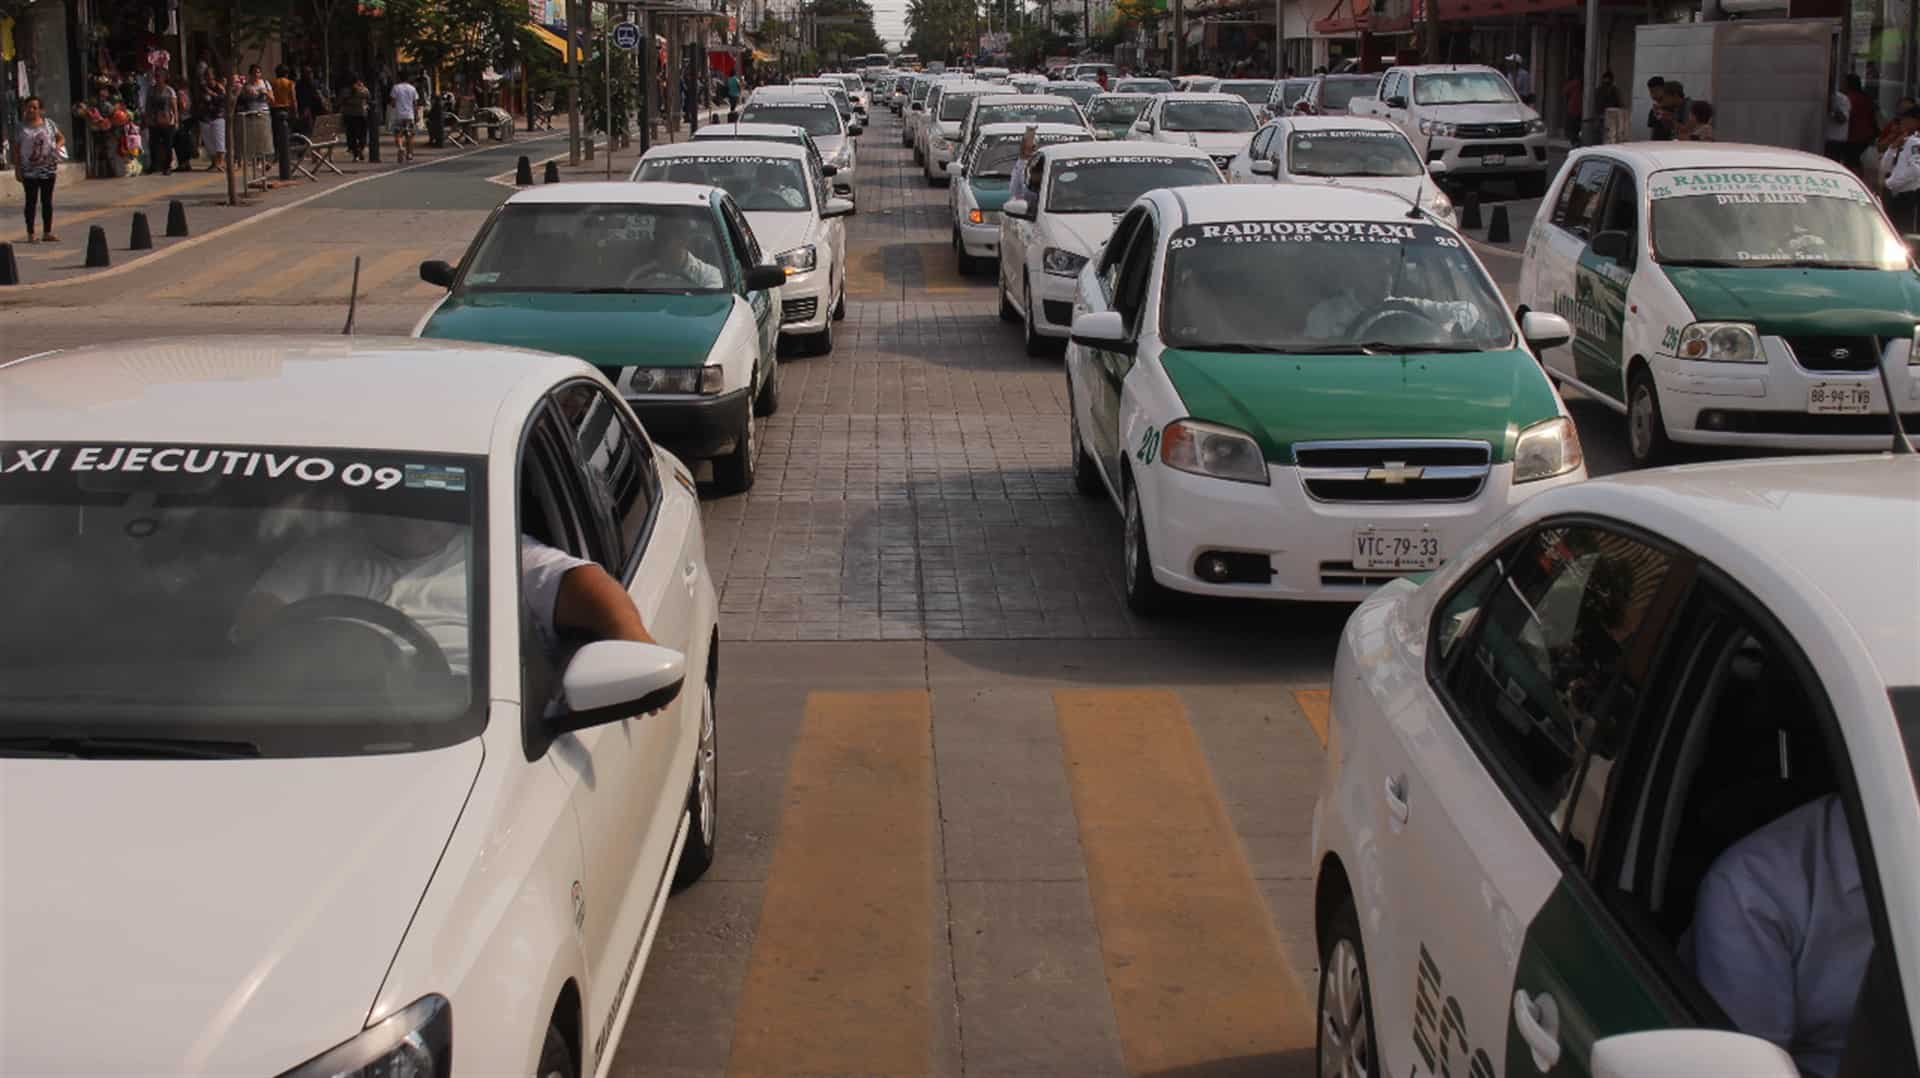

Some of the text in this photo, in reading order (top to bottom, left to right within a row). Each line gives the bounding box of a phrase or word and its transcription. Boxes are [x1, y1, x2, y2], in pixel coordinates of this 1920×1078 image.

[1672, 174, 1841, 189] RADIOECOTAXI
[1202, 222, 1417, 240] RADIOECOTAXI
[1170, 236, 1197, 249] 20
[1434, 235, 1460, 248] 20
[1137, 424, 1161, 465] 20
[0, 448, 62, 473] XI
[70, 447, 336, 482] EJECUTIVO
[341, 462, 404, 490] 09
[1357, 536, 1439, 557] VTC-79-33
